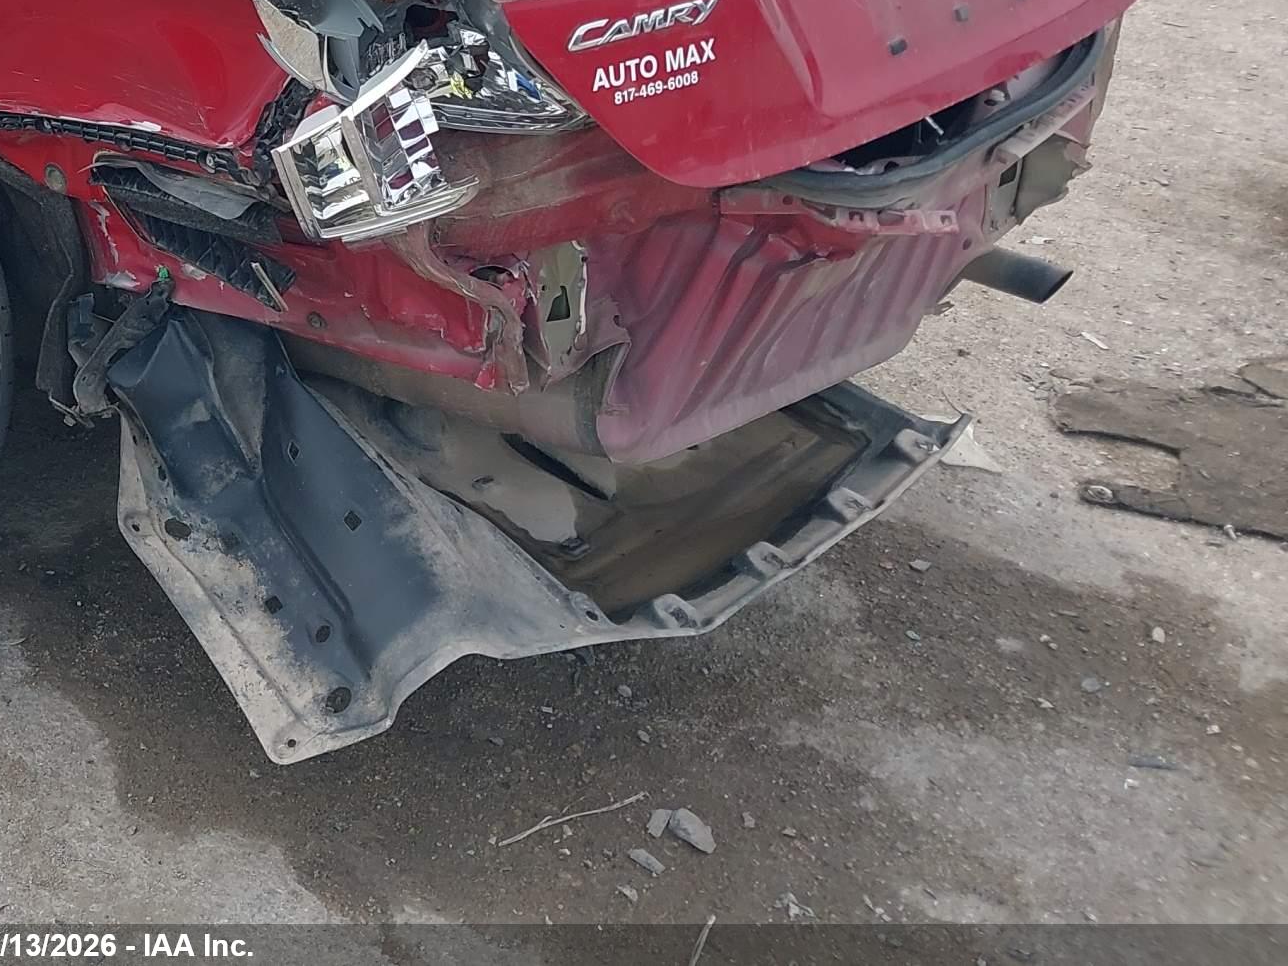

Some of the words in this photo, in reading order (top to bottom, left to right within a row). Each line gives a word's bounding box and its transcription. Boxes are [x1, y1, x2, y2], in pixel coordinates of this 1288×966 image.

[592, 54, 658, 91] AUTO
[665, 38, 716, 73] MAX
[614, 71, 699, 104] 817-469-6008
